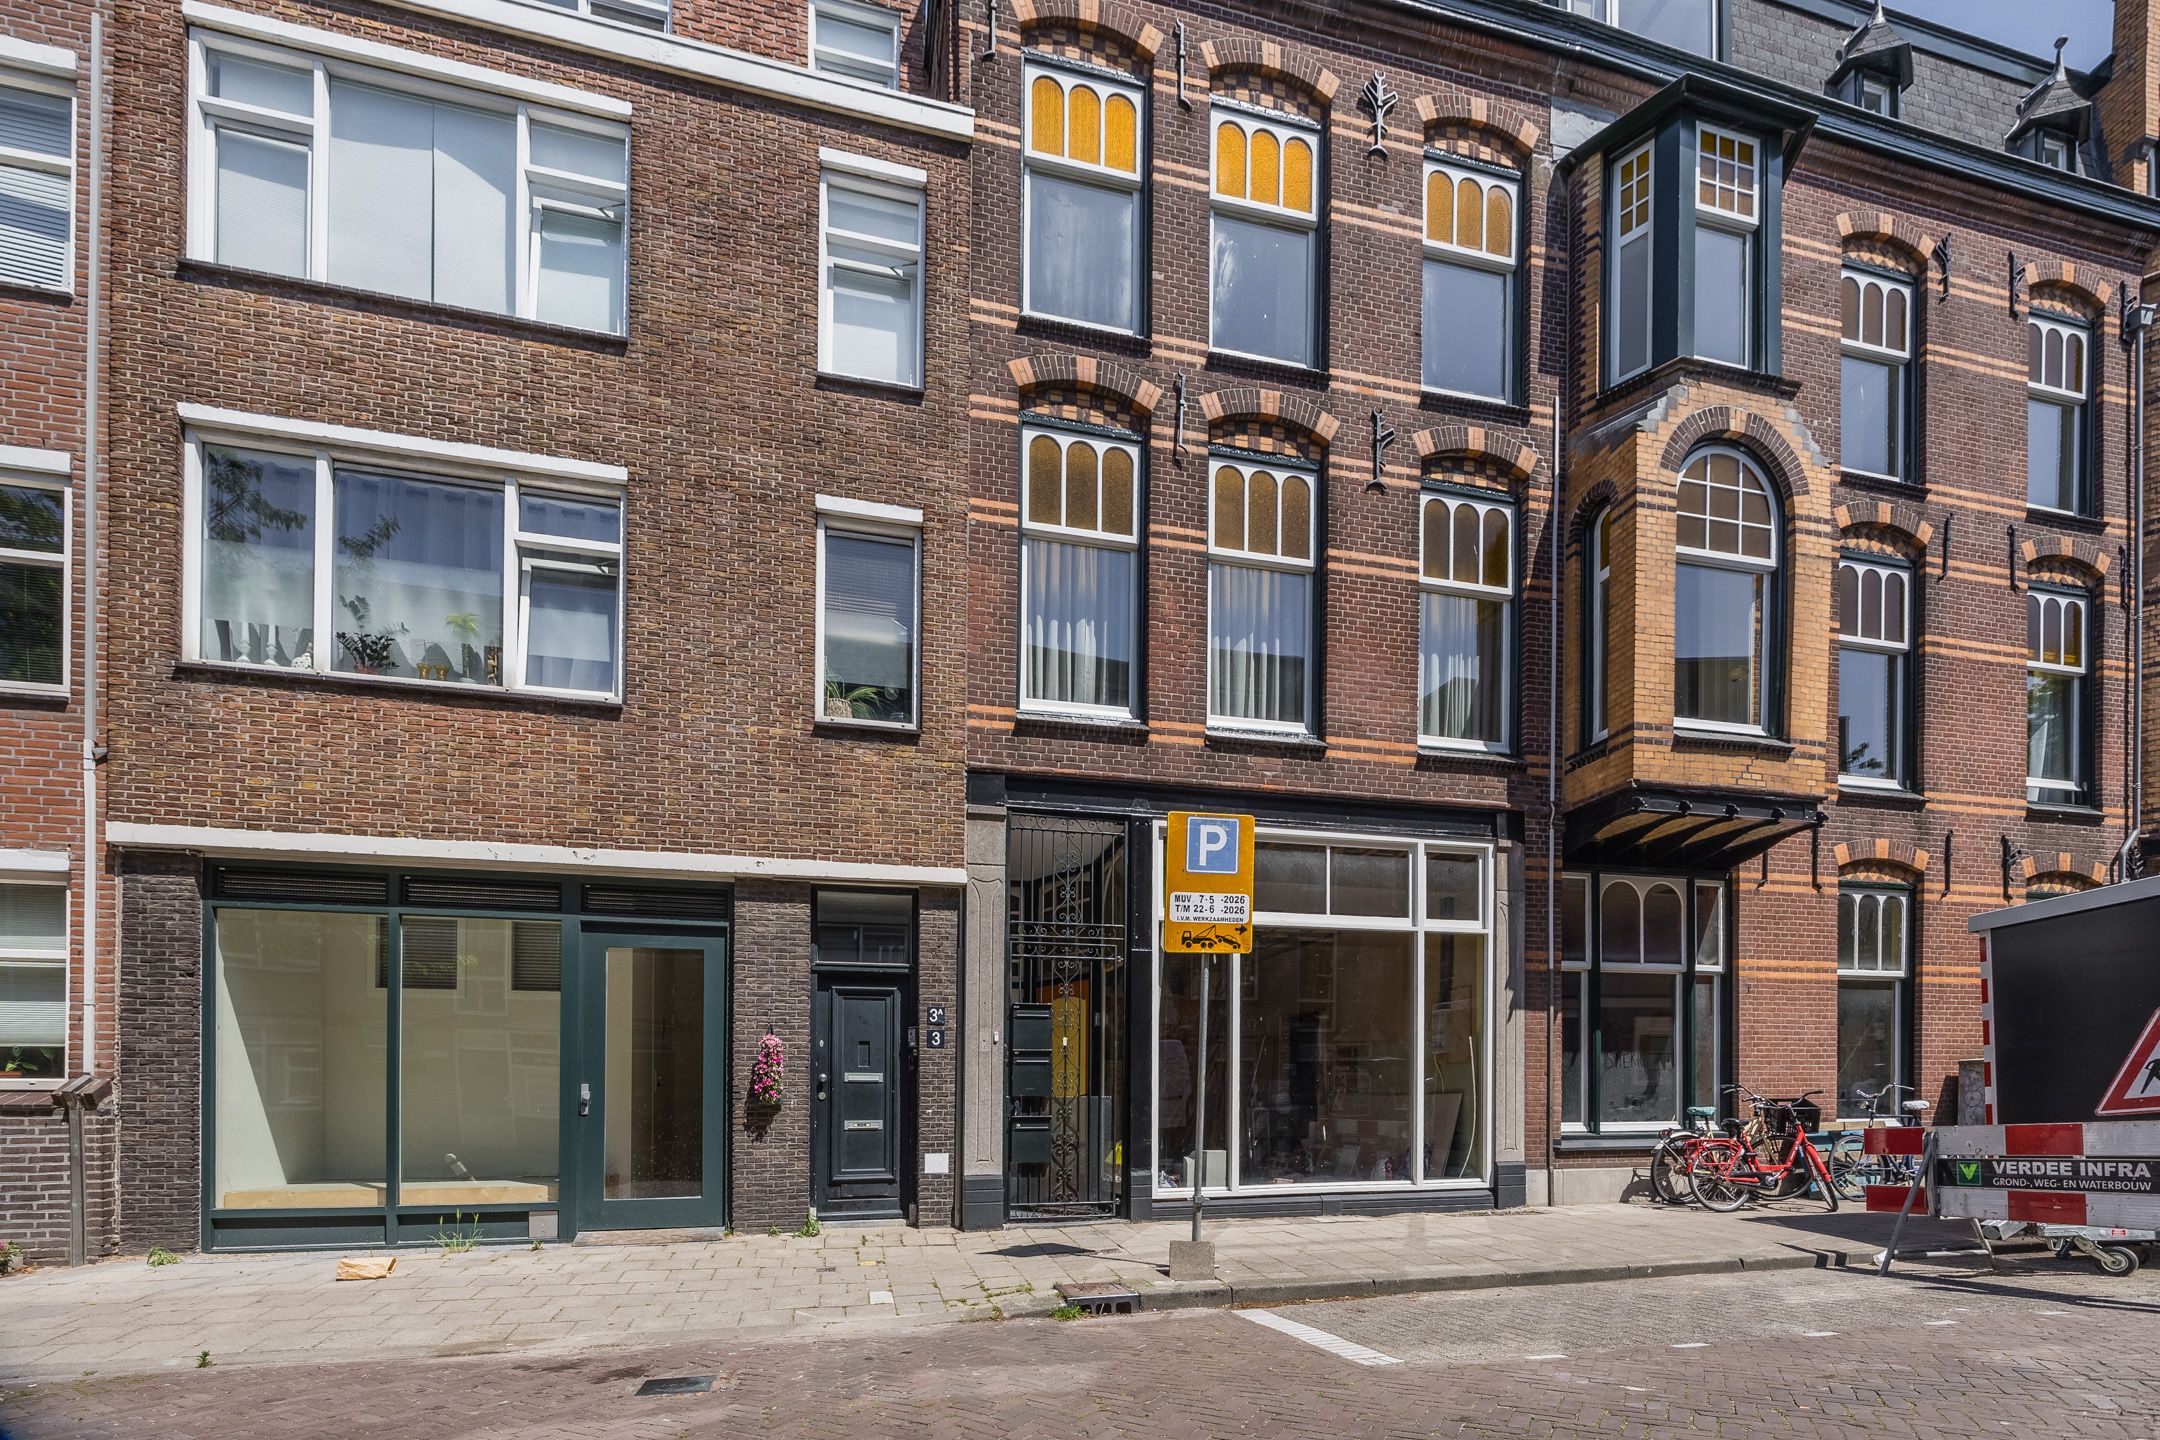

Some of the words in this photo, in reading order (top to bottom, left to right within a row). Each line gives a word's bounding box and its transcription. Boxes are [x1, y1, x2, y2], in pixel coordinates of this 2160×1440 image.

[1199, 824, 1228, 867] P
[1175, 904, 1191, 913] T/M
[931, 1031, 941, 1046] 3
[1991, 1161, 2073, 1176] VERDEE
[2079, 1161, 2152, 1178] INFRA
[2033, 1178, 2061, 1188] WEG-
[2063, 1179, 2077, 1188] EN
[2078, 1180, 2152, 1191] WATERBOUW
